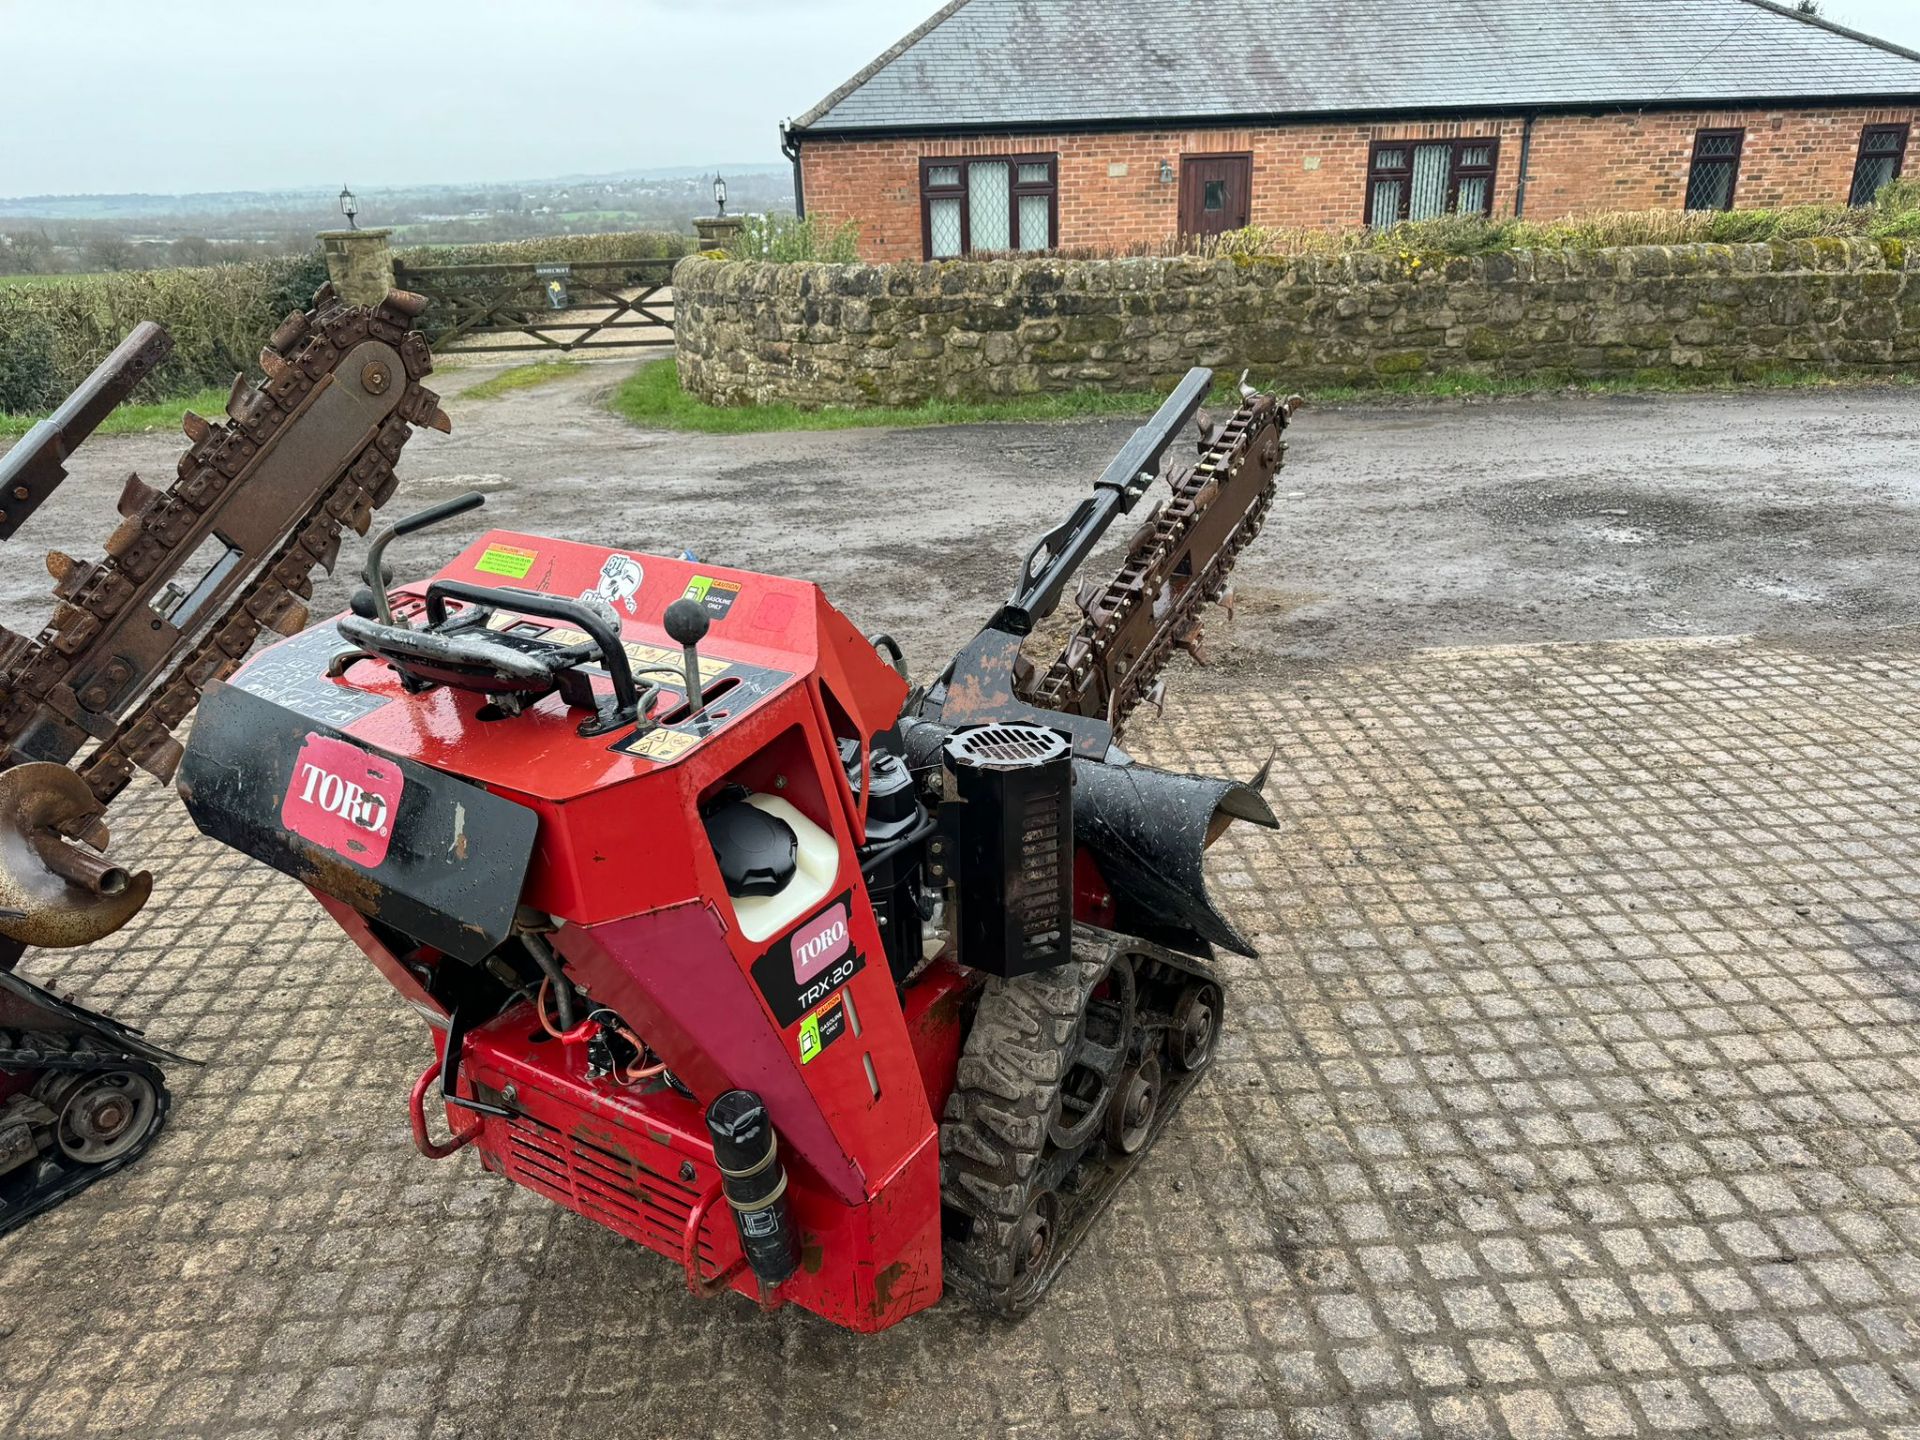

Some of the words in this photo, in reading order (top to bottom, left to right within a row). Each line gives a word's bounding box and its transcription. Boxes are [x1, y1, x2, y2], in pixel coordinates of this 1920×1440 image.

[713, 580, 740, 591] CAUTION
[704, 594, 733, 606] GASOLINE
[707, 602, 723, 610] ONLY
[298, 762, 388, 835] TORO
[796, 920, 845, 967] TORO
[817, 995, 841, 1017] CAUTION
[818, 1011, 843, 1033] GASOLINE
[825, 1021, 839, 1036] ONLY
